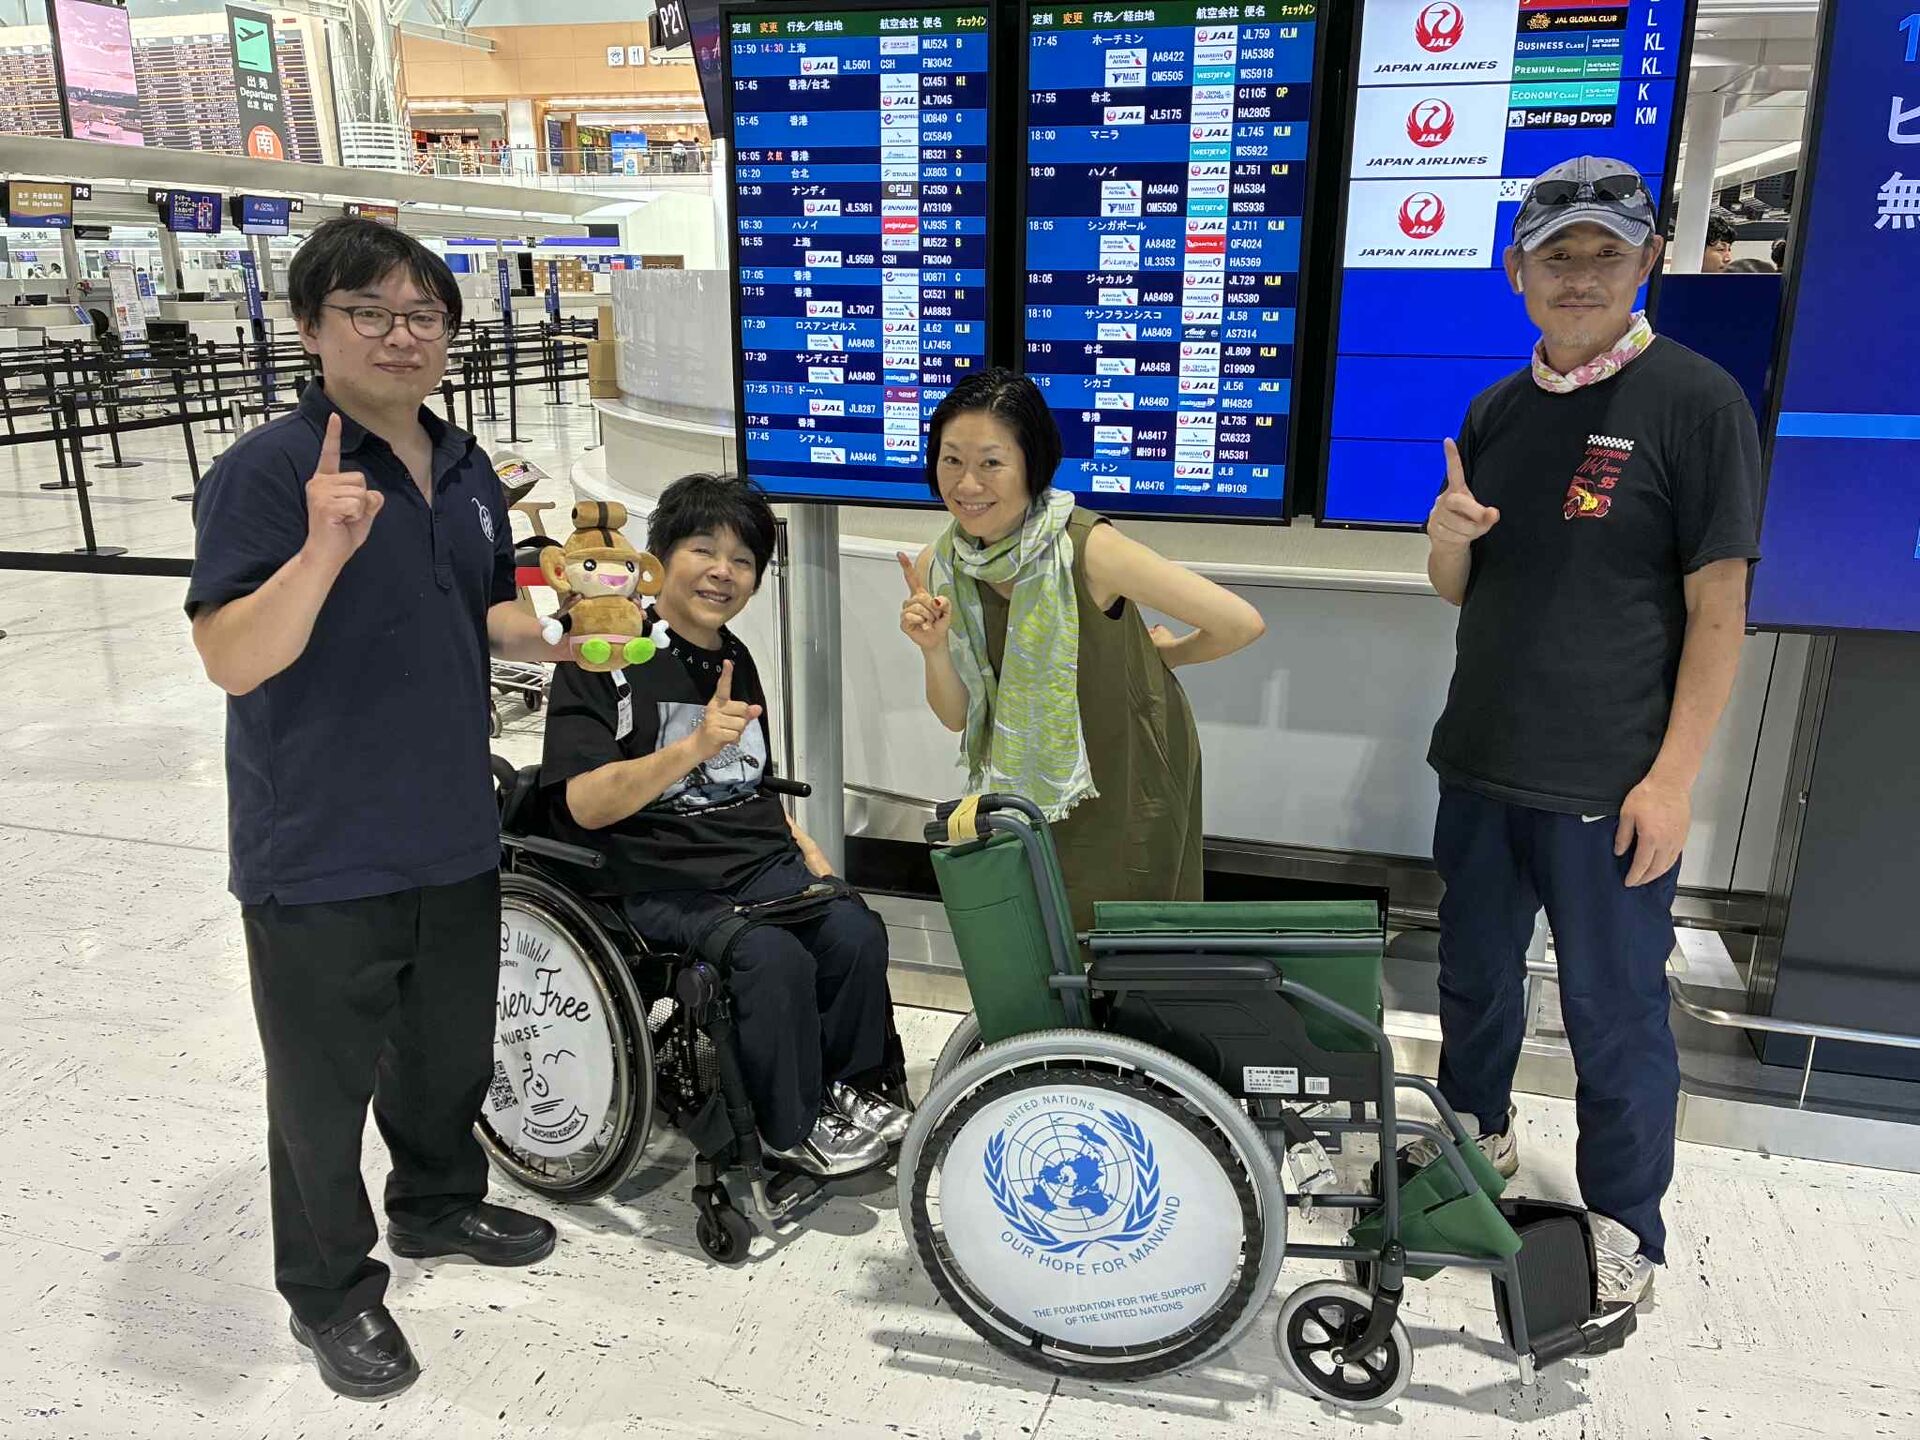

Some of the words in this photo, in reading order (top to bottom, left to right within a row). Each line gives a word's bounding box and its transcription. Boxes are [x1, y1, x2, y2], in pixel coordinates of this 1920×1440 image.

[660, 1, 683, 38] P21
[1033, 14, 1052, 25] 定刻
[1063, 12, 1083, 24] 変更
[1196, 7, 1239, 19] 航空会社
[1245, 6, 1265, 17] 便名
[1648, 9, 1657, 26] L
[732, 23, 751, 34] 定刻
[760, 22, 778, 33] 変更
[880, 18, 919, 29] 航空会社
[923, 17, 942, 28] 便名
[1033, 36, 1058, 46] 17:45
[1093, 34, 1144, 45] ホーチミン
[1243, 29, 1270, 40] JL759
[1280, 28, 1298, 38] KLM
[1426, 38, 1454, 47] JAL
[1645, 33, 1665, 51] KL
[734, 45, 756, 54] 13:50
[760, 44, 783, 53] 14:30
[788, 43, 807, 53] 上海
[923, 39, 947, 49] MU524
[1152, 51, 1184, 62] AA8422
[1242, 48, 1274, 60] HA5386
[843, 60, 871, 70] JL5601
[881, 60, 895, 69] CSH
[923, 58, 952, 68] FM3042
[1374, 64, 1422, 73] JAPAN
[1425, 61, 1498, 71] AIRLINES
[1641, 58, 1662, 75] KL
[1240, 68, 1273, 79] WS5918
[735, 80, 758, 90] 15:45
[923, 77, 947, 86] CX451
[240, 87, 277, 101] Departures
[1638, 83, 1650, 101] K
[923, 95, 952, 105] JL7045
[1032, 93, 1057, 104] 17:55
[1091, 92, 1110, 103] 台北
[1150, 109, 1182, 120] JL5175
[1238, 108, 1271, 118] HA2805
[1527, 112, 1552, 124] Self
[1554, 112, 1577, 126] Bag
[1581, 111, 1612, 125] Drop
[1635, 107, 1657, 125] KM
[736, 116, 759, 126] 15:45
[1031, 130, 1056, 140] 18:00
[1090, 130, 1120, 140] マニラ
[1237, 127, 1264, 137] JL745
[1274, 126, 1291, 136] KLM
[1418, 133, 1444, 142] JAL
[254, 129, 274, 154] 南
[738, 152, 760, 161] 16:05
[791, 150, 809, 161] 香港
[923, 150, 946, 159] HB321
[1236, 146, 1268, 156] WS5922
[1366, 158, 1414, 166] JAPAN
[1416, 157, 1488, 165] AIRLINES
[739, 169, 760, 178] 16:20
[791, 168, 809, 178] 台北
[1030, 167, 1055, 177] 18:00
[1088, 166, 1118, 177] ハノイ
[1235, 165, 1261, 175] JL751
[1272, 165, 1288, 175] KLM
[76, 188, 89, 198] P6
[739, 186, 761, 195] 16:30
[923, 186, 947, 194] FJ350
[956, 186, 961, 194] A
[1147, 184, 1179, 194] AA8440
[156, 192, 168, 202] P7
[923, 203, 952, 212] AY3109
[740, 221, 763, 230] 16:30
[792, 221, 818, 230] ハノイ
[1030, 221, 1054, 231] 18:05
[1232, 221, 1257, 231] JL711
[1409, 226, 1435, 234] JAL
[741, 237, 763, 246] 16:55
[794, 237, 811, 247] 上海
[923, 238, 947, 247] MU522
[923, 256, 952, 265] FM3040
[1230, 257, 1261, 267] HA5369
[742, 270, 764, 279] 17:05
[1029, 274, 1053, 284] 18:05
[1229, 276, 1255, 285] JL729
[743, 287, 764, 296] 17:15
[923, 290, 946, 299] CX521
[847, 305, 874, 314] JL7047
[1028, 309, 1052, 318] 18:10
[1085, 310, 1162, 320] サンフランシスコ
[1227, 311, 1248, 321] JL58
[744, 320, 765, 328] 17:20
[796, 321, 856, 331] ロスアンゼルス
[923, 324, 942, 333] JL62
[1226, 329, 1257, 339] AS7314
[923, 341, 951, 350] LA7456
[1028, 344, 1051, 353] 18:10
[1084, 344, 1103, 354] 台北
[745, 352, 767, 361] 17:20
[746, 384, 767, 394] 17:25
[772, 385, 794, 395] 17:15
[1084, 378, 1112, 388] シカゴ
[1223, 382, 1244, 391] JL56
[748, 416, 769, 426] 17:45
[1221, 416, 1247, 426] JL735
[749, 432, 770, 441] 17:45
[799, 435, 833, 445] シアトル
[1138, 431, 1167, 440] AA8417
[1218, 467, 1234, 476] JL8
[1597, 477, 1619, 489] 95
[532, 968, 591, 1022] Free
[501, 1025, 540, 1047] NURSE
[1005, 1099, 1040, 1127] UNITED
[1042, 1095, 1095, 1111] NATIONS
[1001, 1231, 1034, 1259] OUR
[1039, 1252, 1086, 1276] HOPE
[1092, 1258, 1127, 1275] FOR
[1129, 1196, 1181, 1263] MANKIND
[1033, 1308, 1053, 1319] THE
[1054, 1300, 1115, 1315] FOUNDATION
[1117, 1297, 1137, 1307] FOR
[1140, 1293, 1158, 1303] THE
[1161, 1283, 1208, 1300] SUPPORT
[1065, 1317, 1079, 1326] OF
[1081, 1313, 1100, 1324] THE
[1101, 1307, 1137, 1321] UNITED
[1140, 1301, 1184, 1317] NATIONS
